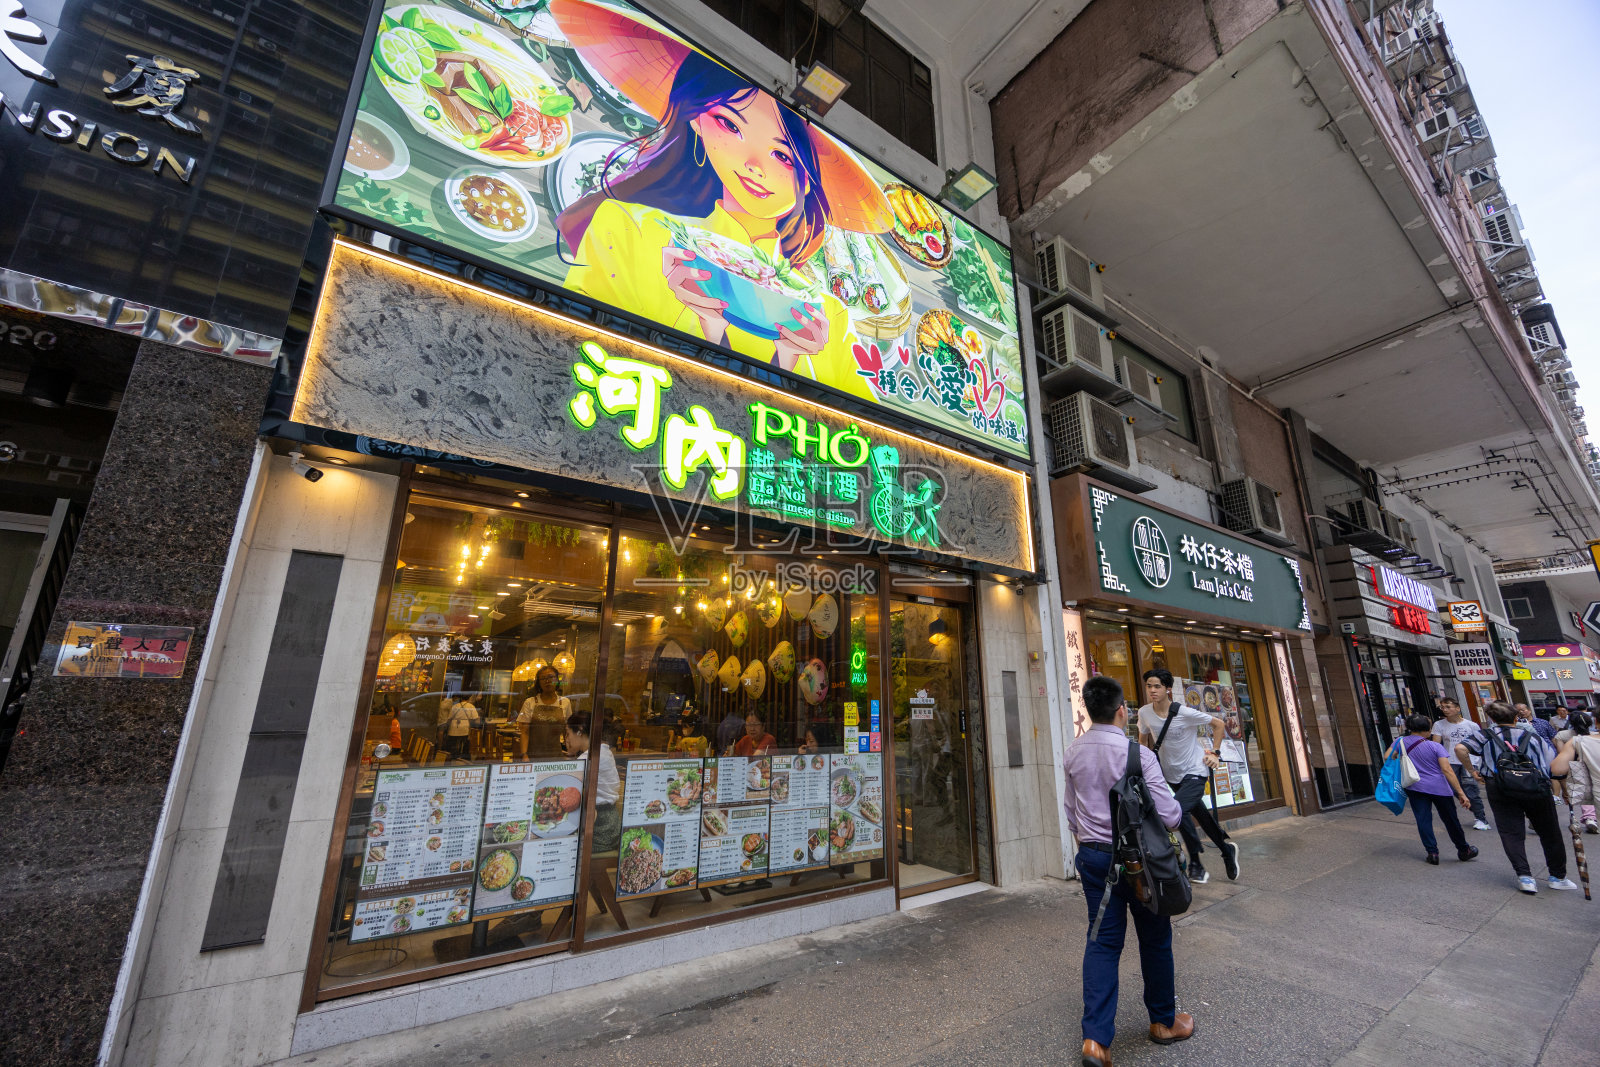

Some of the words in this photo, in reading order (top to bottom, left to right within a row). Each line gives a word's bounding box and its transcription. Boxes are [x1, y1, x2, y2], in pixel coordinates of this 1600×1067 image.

[750, 447, 859, 502] 越式料理
[751, 477, 774, 496] Ha
[780, 484, 806, 503] Noi
[751, 494, 814, 517] Vietnamese
[816, 508, 856, 526] Cuisine
[1180, 534, 1255, 582] 林仔茶檔
[1191, 570, 1216, 594] Lam
[1454, 649, 1489, 658] AJISEN
[1456, 657, 1492, 667] RAMEN
